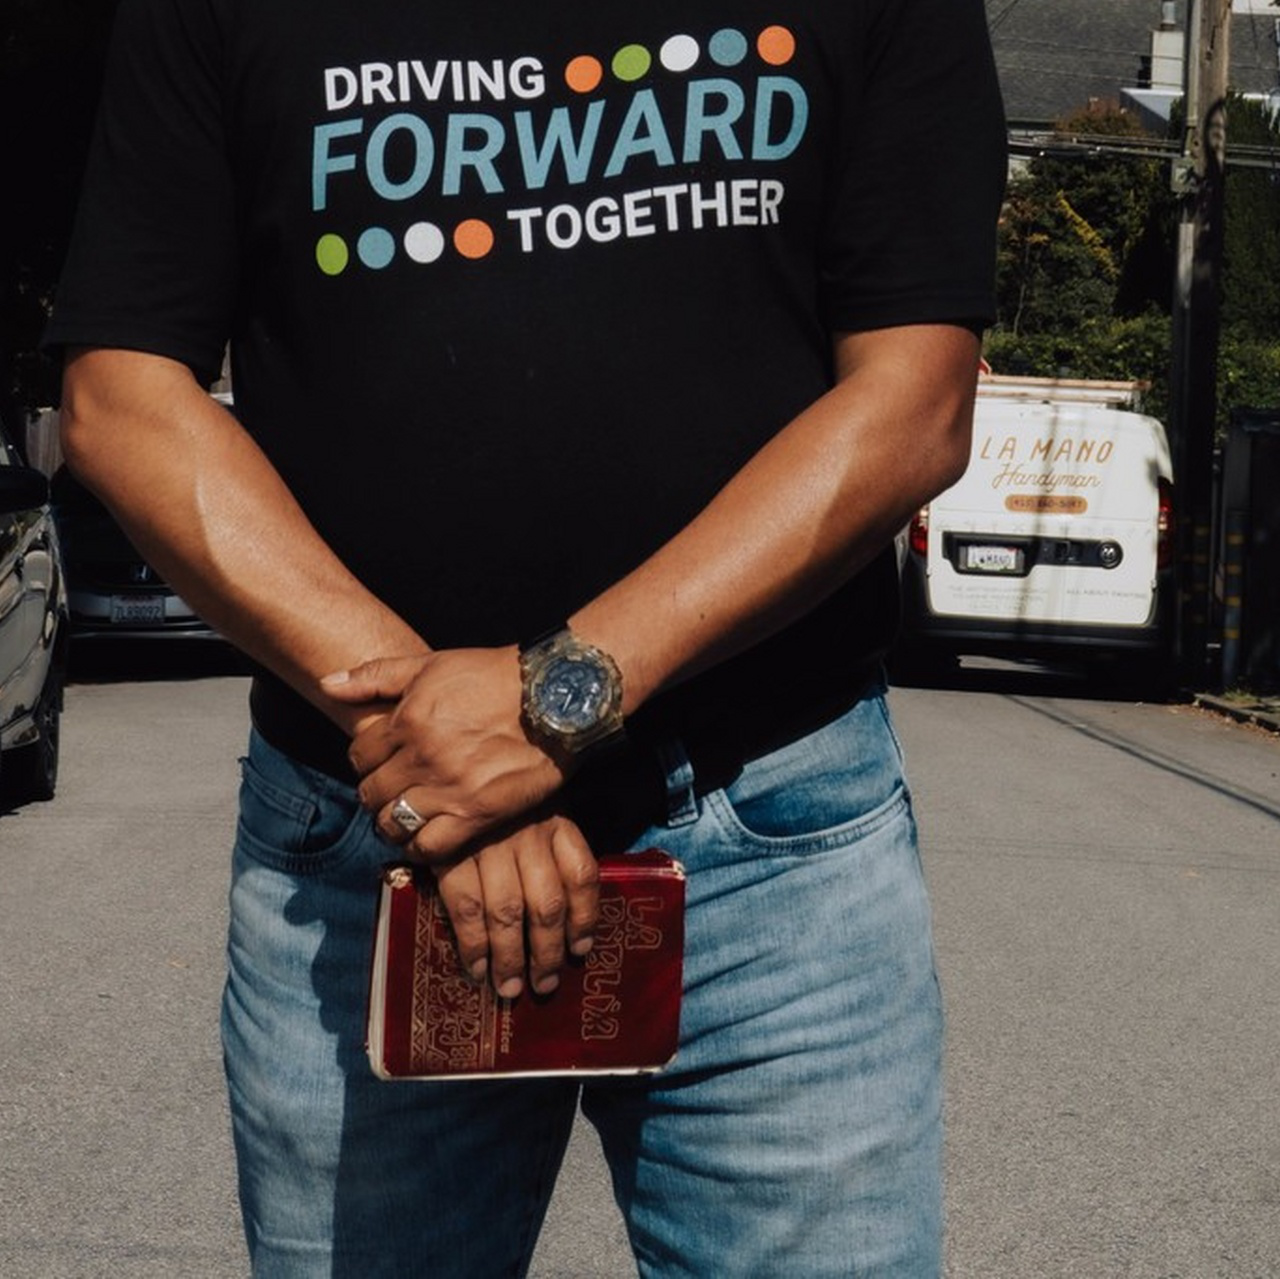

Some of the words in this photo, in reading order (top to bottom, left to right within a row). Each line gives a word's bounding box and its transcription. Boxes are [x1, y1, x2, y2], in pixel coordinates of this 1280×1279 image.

[324, 57, 545, 110] DRIVING
[312, 76, 809, 211] FORWARD
[507, 179, 784, 252] TOGETHER
[980, 437, 1016, 459] LA
[1031, 439, 1114, 463] MANO
[991, 463, 1102, 493] Handyman
[624, 895, 663, 950] LA
